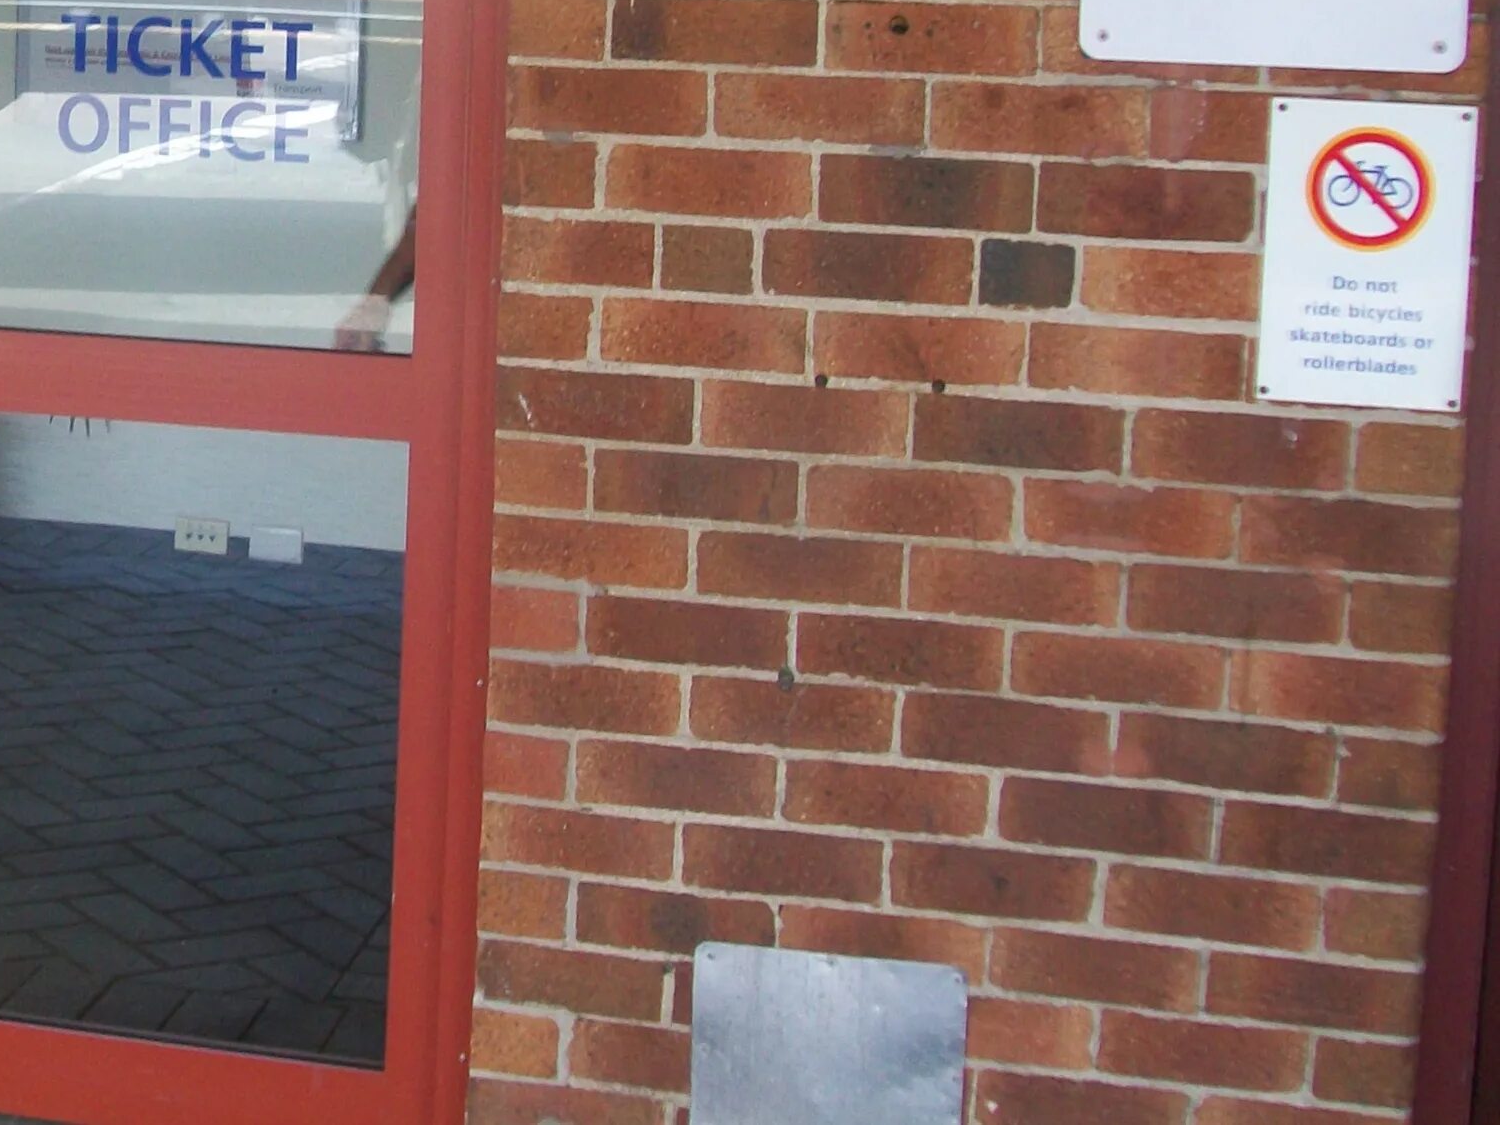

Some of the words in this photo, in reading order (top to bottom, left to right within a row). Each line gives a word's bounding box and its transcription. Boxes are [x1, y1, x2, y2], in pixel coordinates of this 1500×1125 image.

[61, 14, 314, 81] TICKET
[57, 93, 311, 165] OFFICE
[1332, 276, 1358, 291] Do
[1366, 279, 1398, 293] not
[1304, 301, 1341, 317] ride
[1348, 303, 1424, 323] bicycles
[1289, 327, 1408, 349] skateboards
[1414, 337, 1434, 350] or
[1303, 355, 1418, 376] rollerblades
